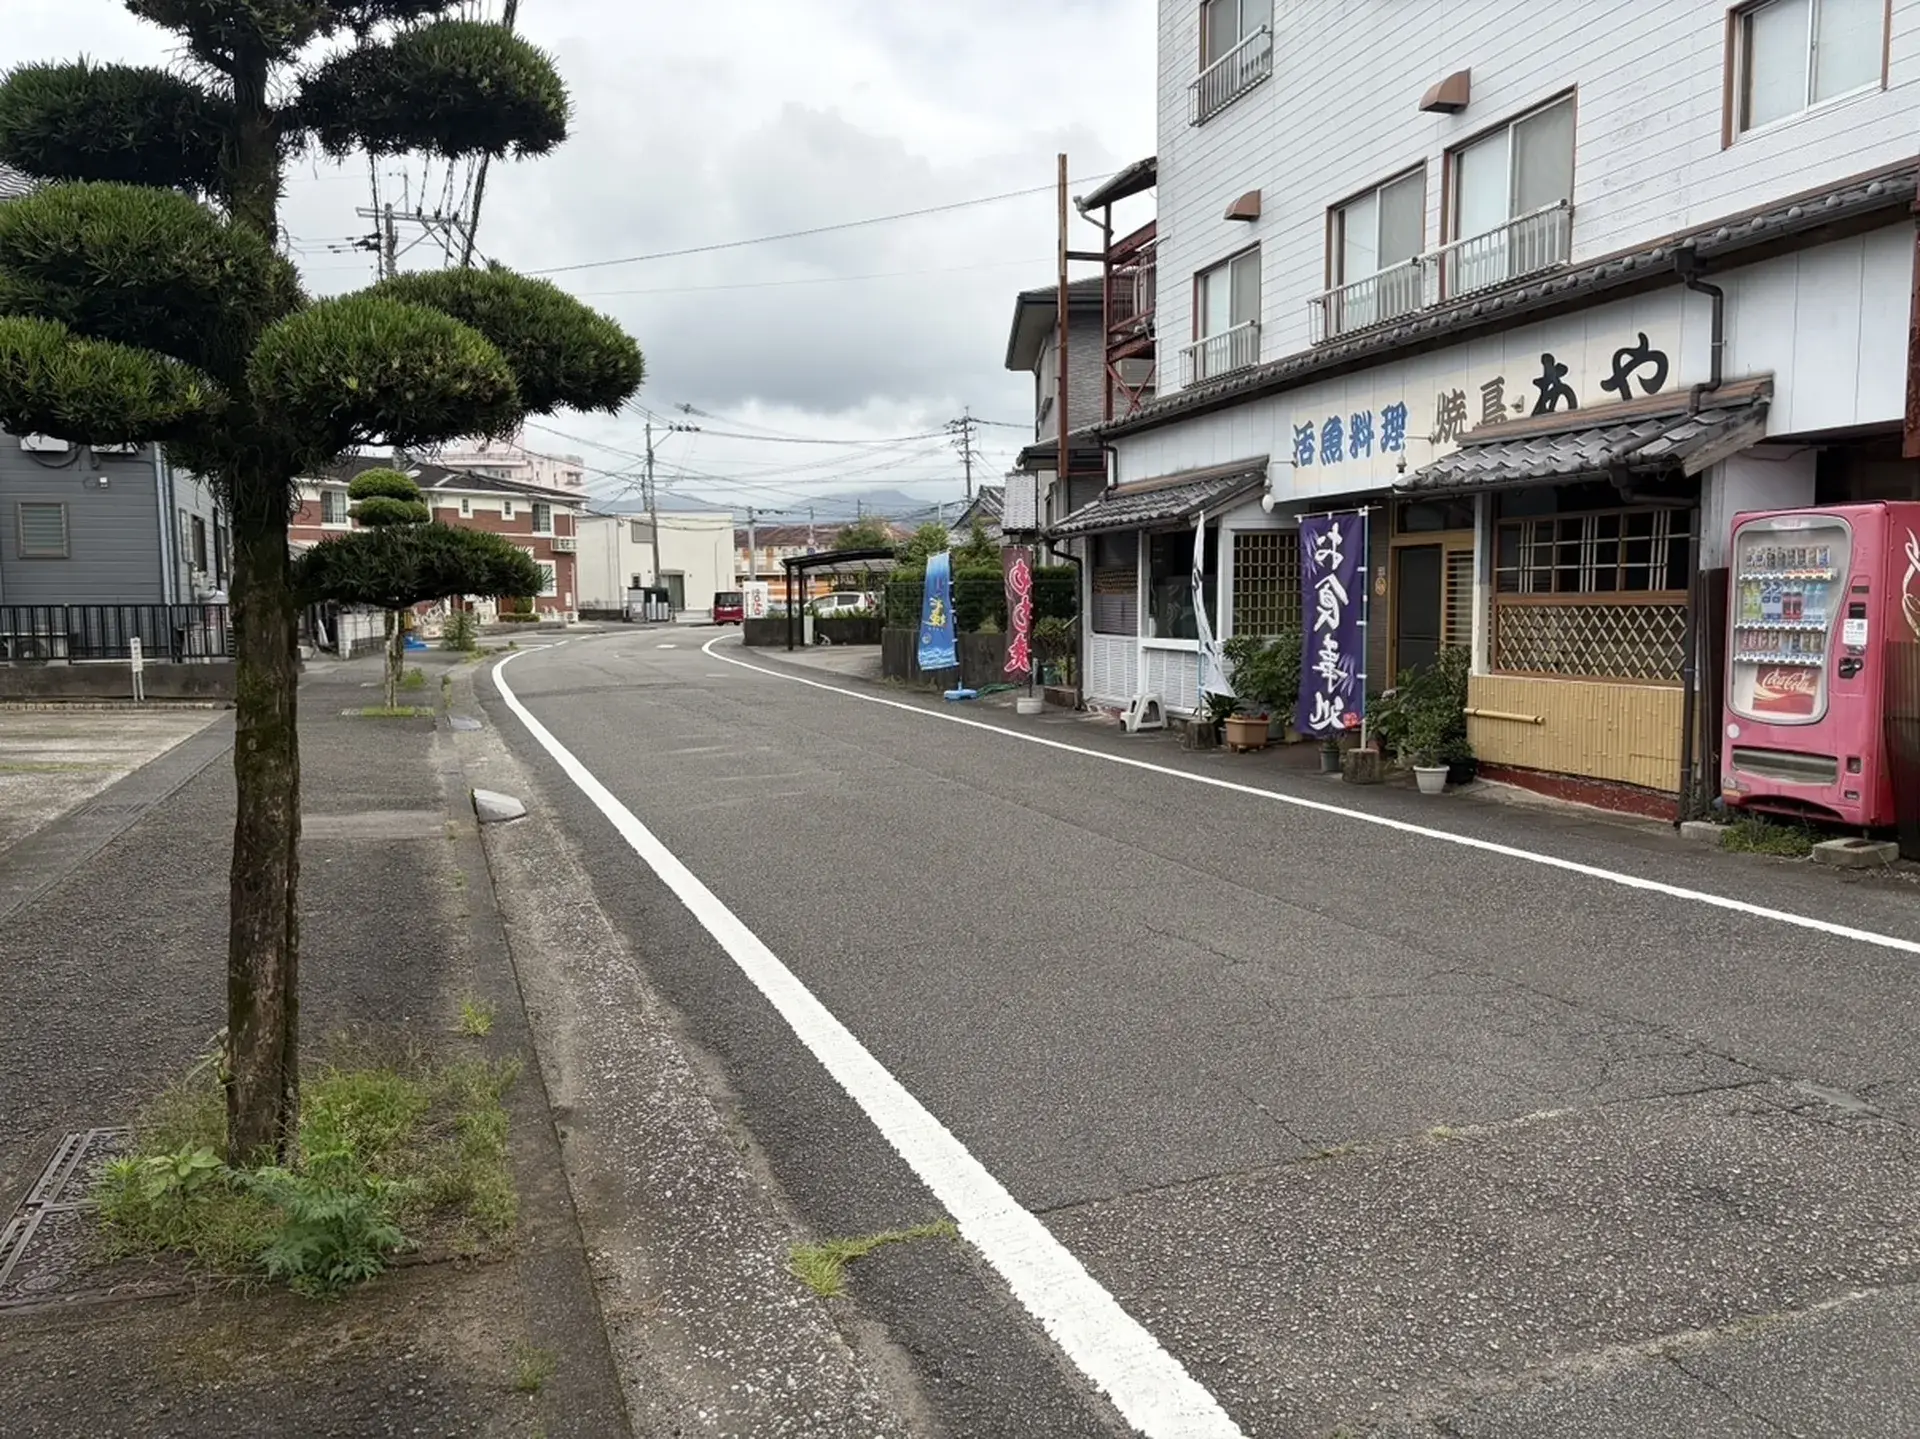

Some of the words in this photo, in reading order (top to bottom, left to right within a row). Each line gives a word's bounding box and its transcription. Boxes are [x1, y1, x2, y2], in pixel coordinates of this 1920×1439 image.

[1292, 401, 1408, 467] 活魚料理
[1436, 376, 1507, 444] 焼鳥
[1531, 332, 1669, 416] あや
[1308, 521, 1350, 731] お食事処
[1762, 667, 1812, 692] Coca-Cola
